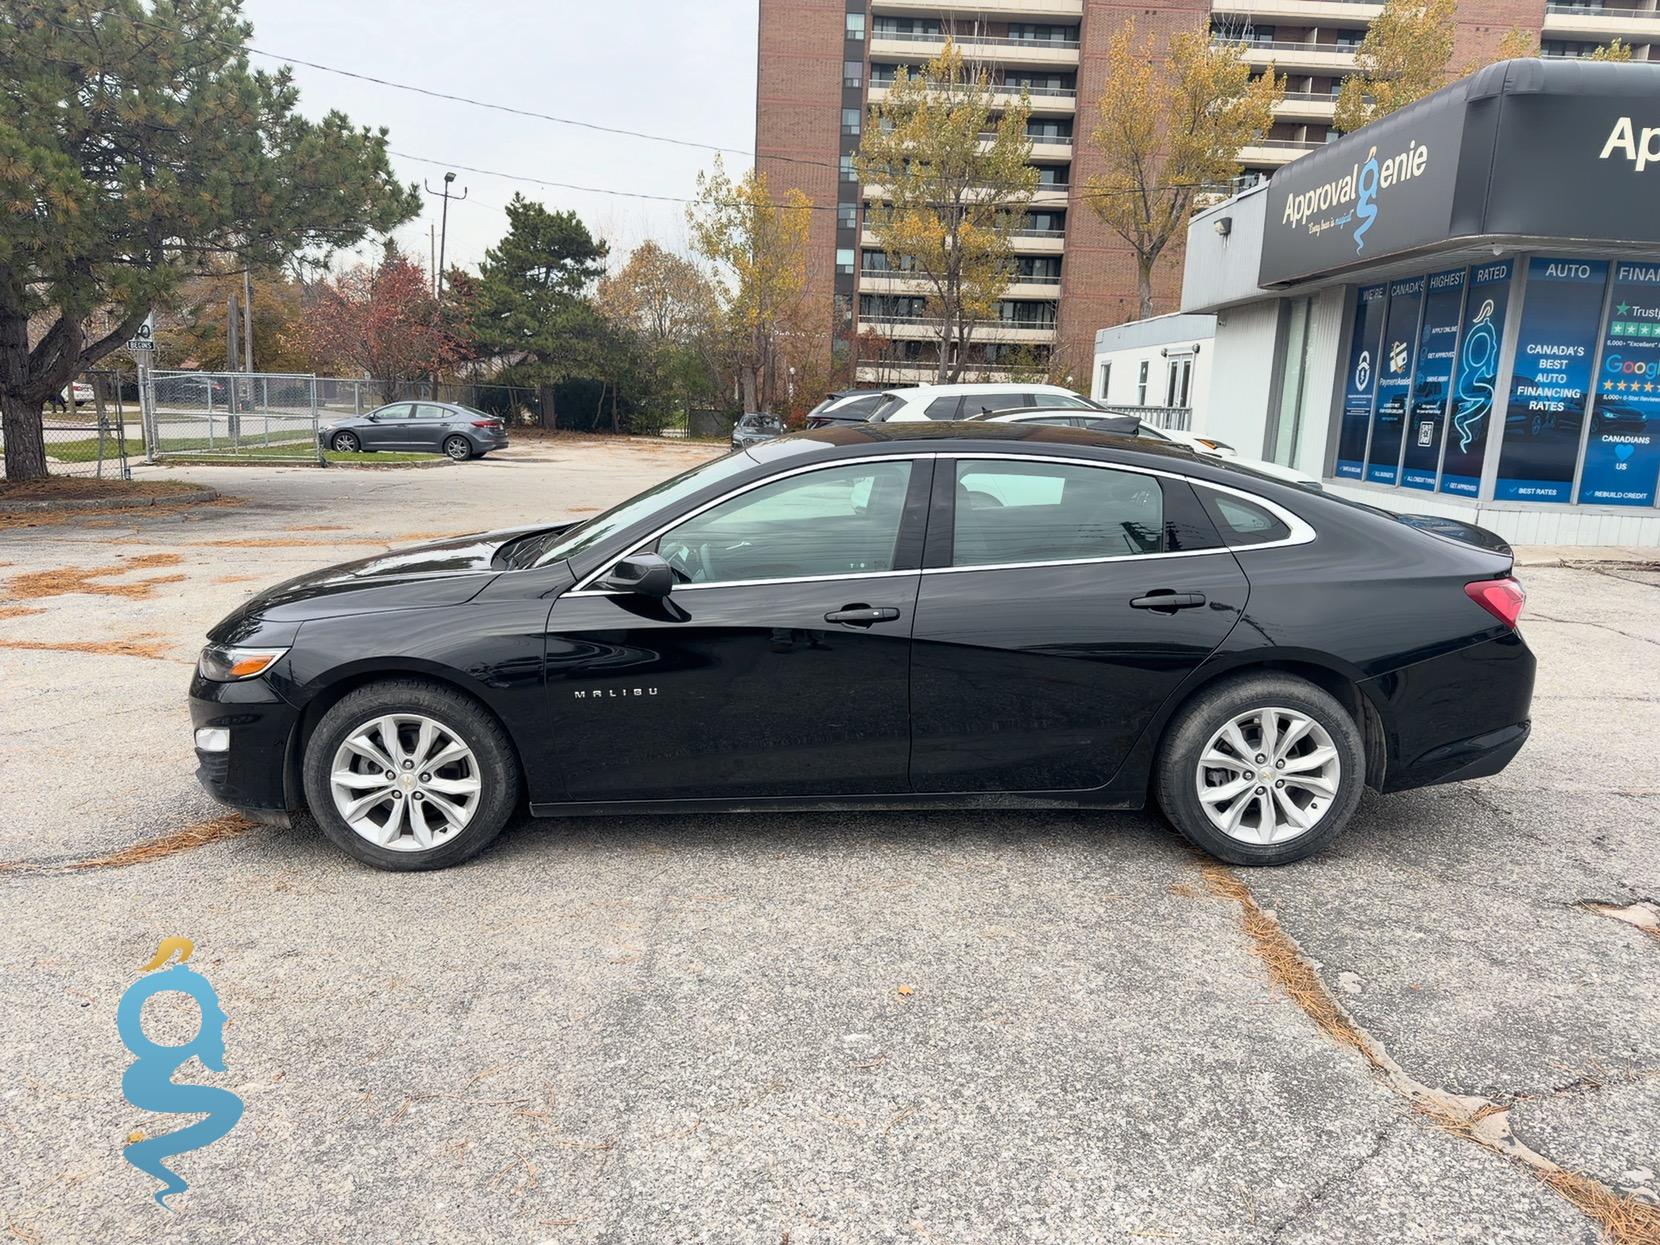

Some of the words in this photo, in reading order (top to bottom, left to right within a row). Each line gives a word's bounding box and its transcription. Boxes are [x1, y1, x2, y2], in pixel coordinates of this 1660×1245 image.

[1363, 287, 1384, 300] WE'RE
[1391, 280, 1424, 296] CANADA'S
[1430, 271, 1466, 289] HIGHEST
[1477, 265, 1507, 282] RATED
[1545, 264, 1590, 278] AUTO
[1632, 306, 1660, 320] Trust
[1527, 344, 1585, 356] CANADA'S
[1539, 359, 1568, 369] BEST
[1535, 373, 1567, 384] AUTO
[1517, 386, 1581, 398] FINANCING
[1528, 401, 1565, 411] RATES
[1601, 435, 1650, 444] CANADIANS
[1518, 487, 1536, 495] BEST
[574, 687, 658, 698] MALIBU
